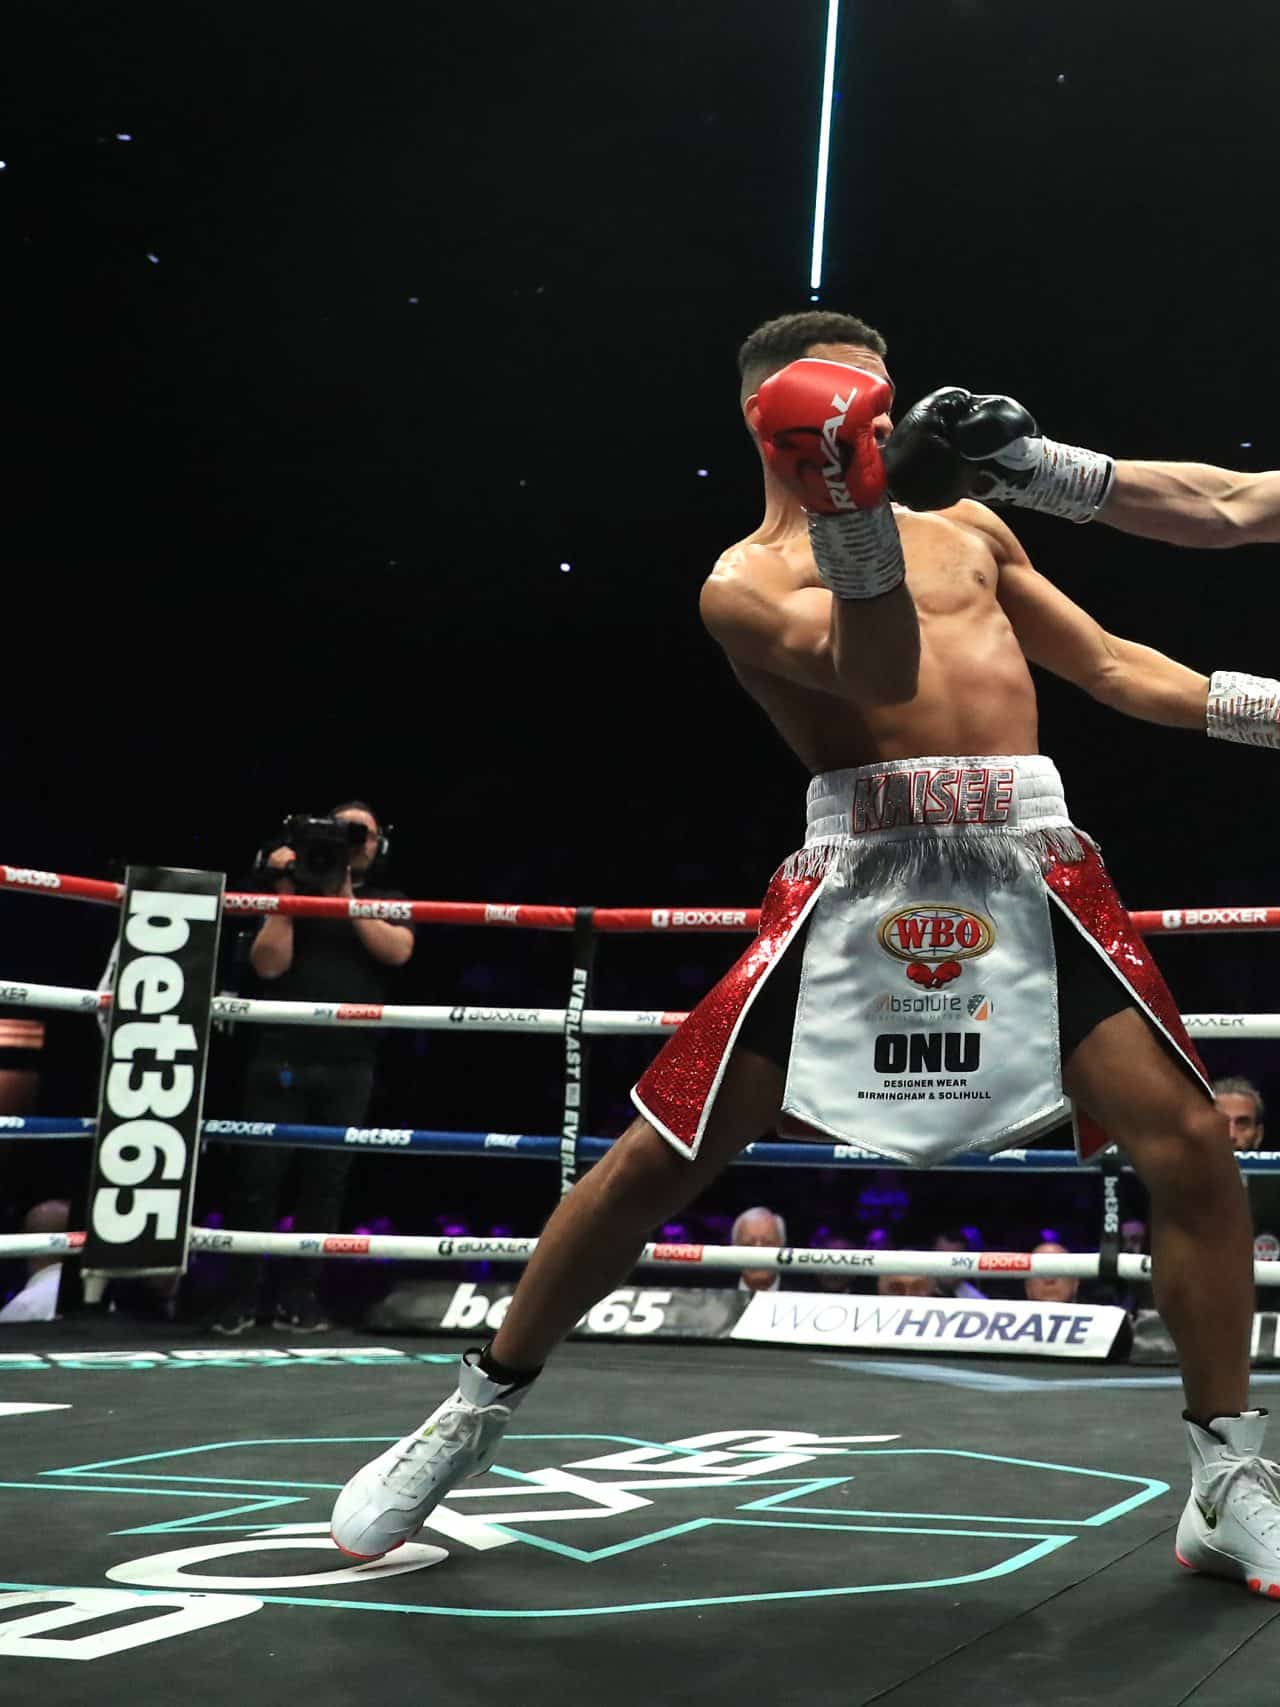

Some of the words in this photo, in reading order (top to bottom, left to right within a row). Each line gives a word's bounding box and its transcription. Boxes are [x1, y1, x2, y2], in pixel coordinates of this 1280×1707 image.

[820, 387, 858, 510] RIVAL
[852, 768, 1014, 835] KAISEE
[222, 895, 280, 910] OXXER
[348, 899, 413, 920] bet365
[672, 911, 747, 926] BOXXER
[1185, 908, 1268, 926] BOXXER
[896, 916, 982, 950] WBO
[565, 967, 588, 1080] EVERLAST
[92, 889, 219, 1244] bet365
[874, 1032, 981, 1074] ONU
[857, 1091, 926, 1101] BIRMINGHAM
[928, 1092, 936, 1100] &
[938, 1091, 992, 1100] SOLIHULL
[883, 1079, 934, 1088] DESIGNER
[936, 1079, 968, 1087] WEAR
[205, 1119, 276, 1136] BOXXER
[344, 1127, 415, 1147] bet365
[560, 1109, 580, 1198] EVERLA
[1104, 1176, 1120, 1234] bet365
[951, 1256, 975, 1270] sky
[979, 1253, 1031, 1271] sports
[440, 1282, 673, 1335] be65
